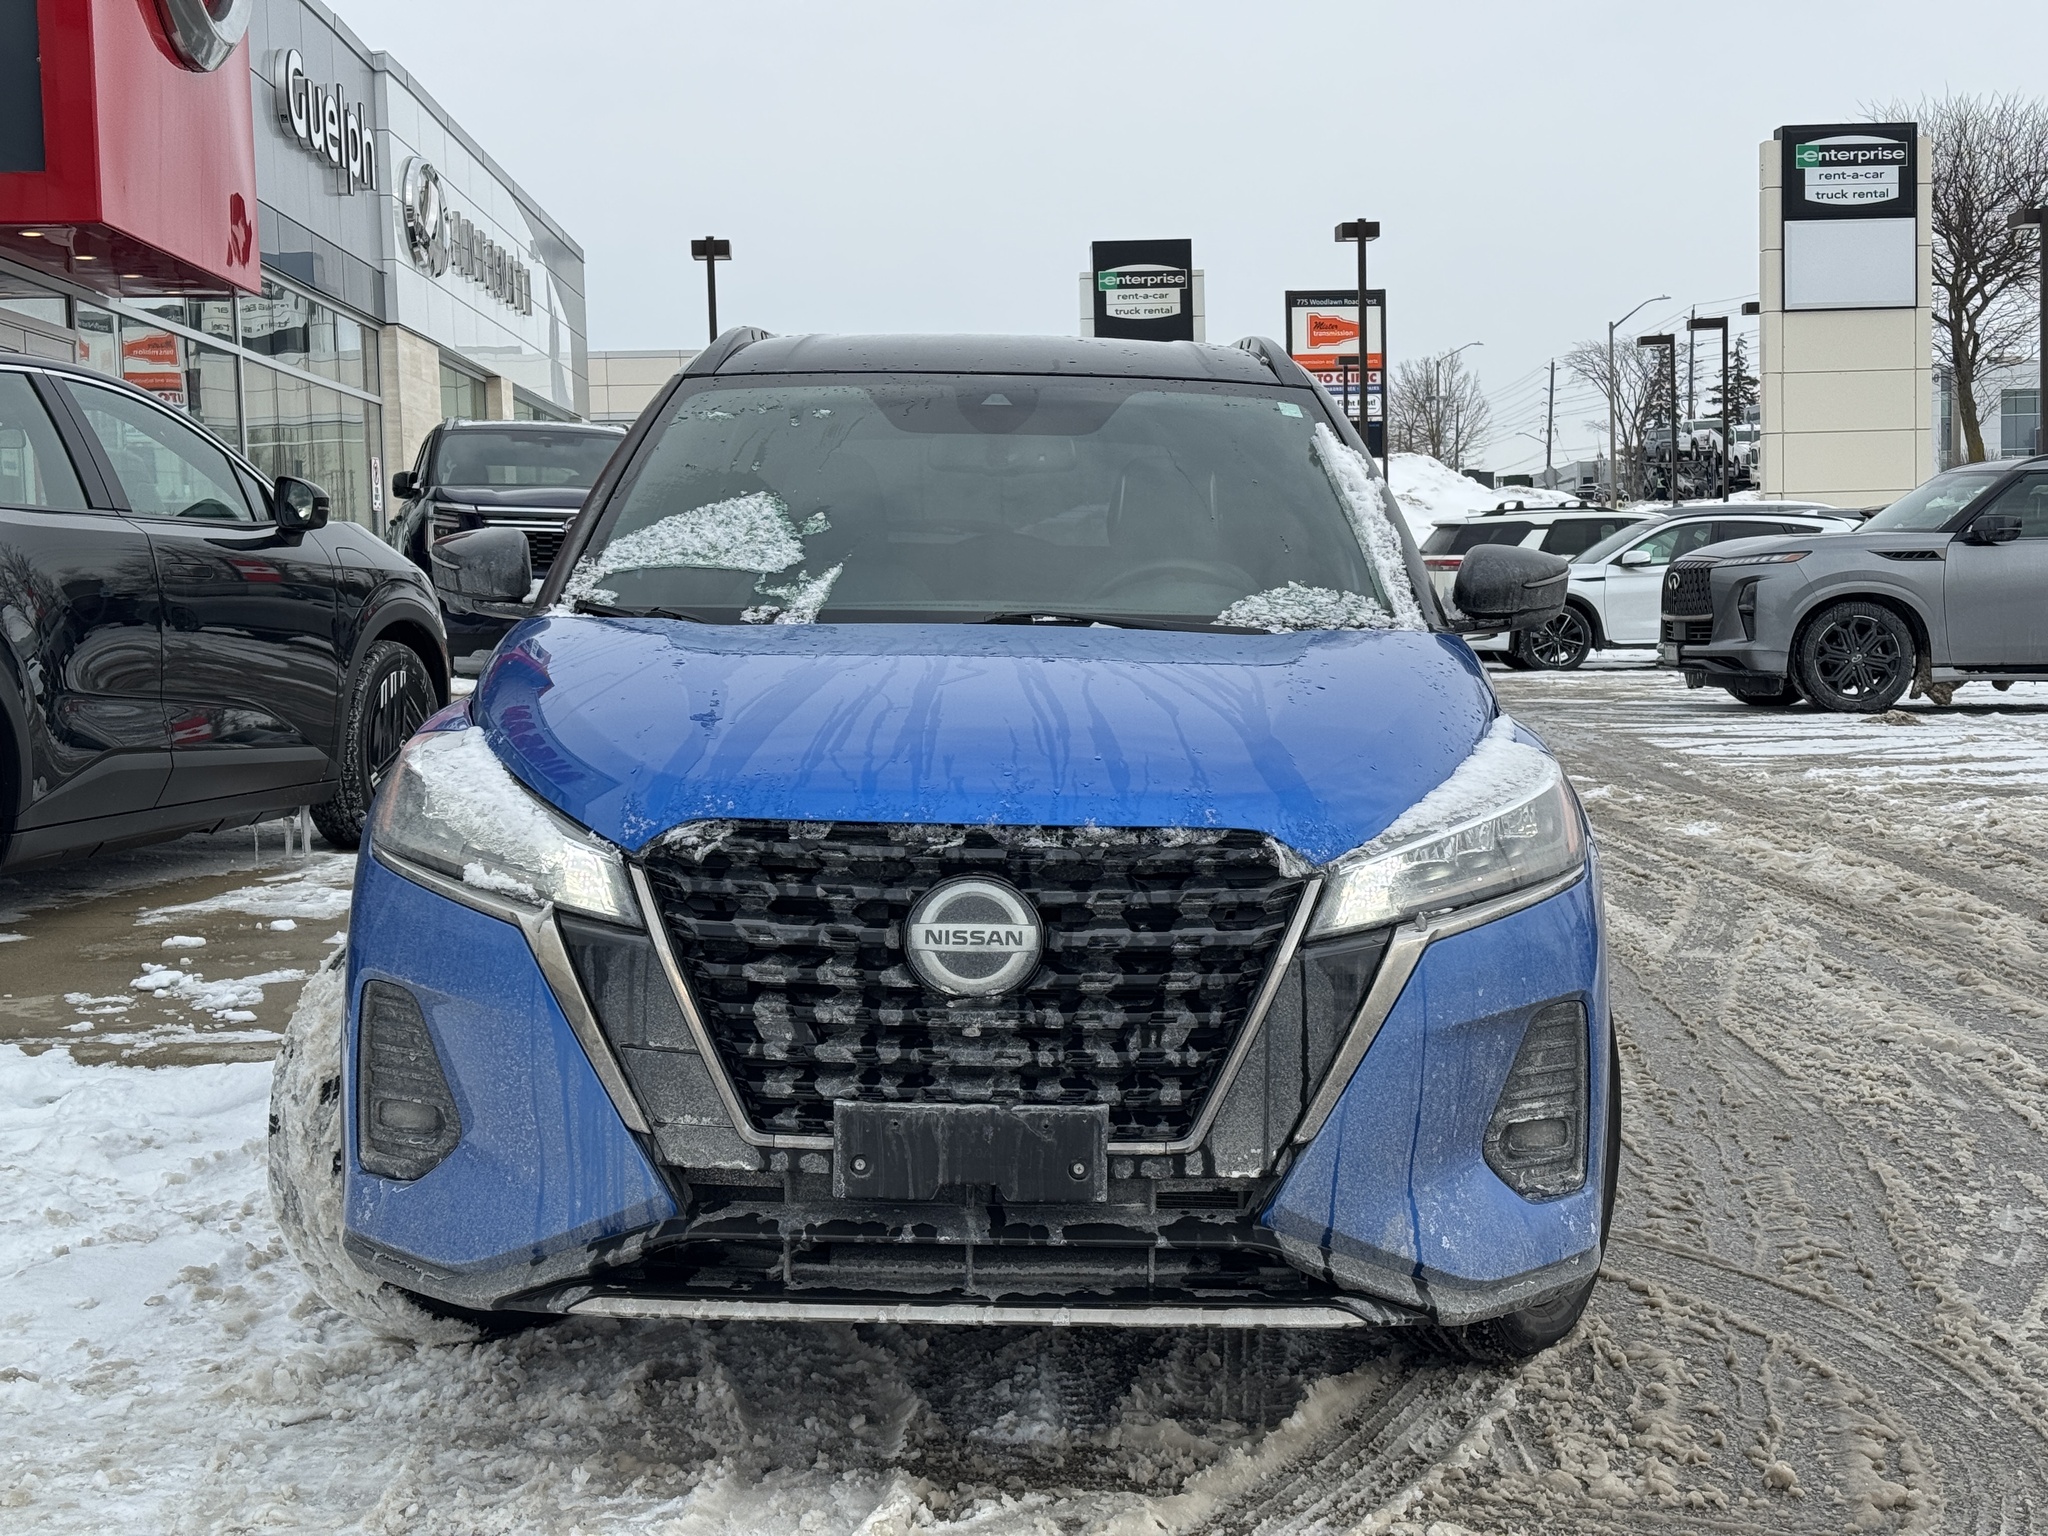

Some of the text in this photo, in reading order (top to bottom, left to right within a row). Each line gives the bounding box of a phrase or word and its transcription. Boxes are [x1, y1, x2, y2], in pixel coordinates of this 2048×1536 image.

[283, 48, 377, 196] Guelph
[1803, 147, 1906, 163] enterprise
[1818, 171, 1885, 180] rent-a-car
[1815, 188, 1889, 200] truck rental
[1104, 273, 1185, 286] enterprise
[1117, 292, 1169, 300] rent-a-car
[1115, 306, 1173, 315] truck rental
[1313, 321, 1338, 330] Mister
[1316, 373, 1333, 383] TO
[924, 929, 1023, 946] NISSAN
